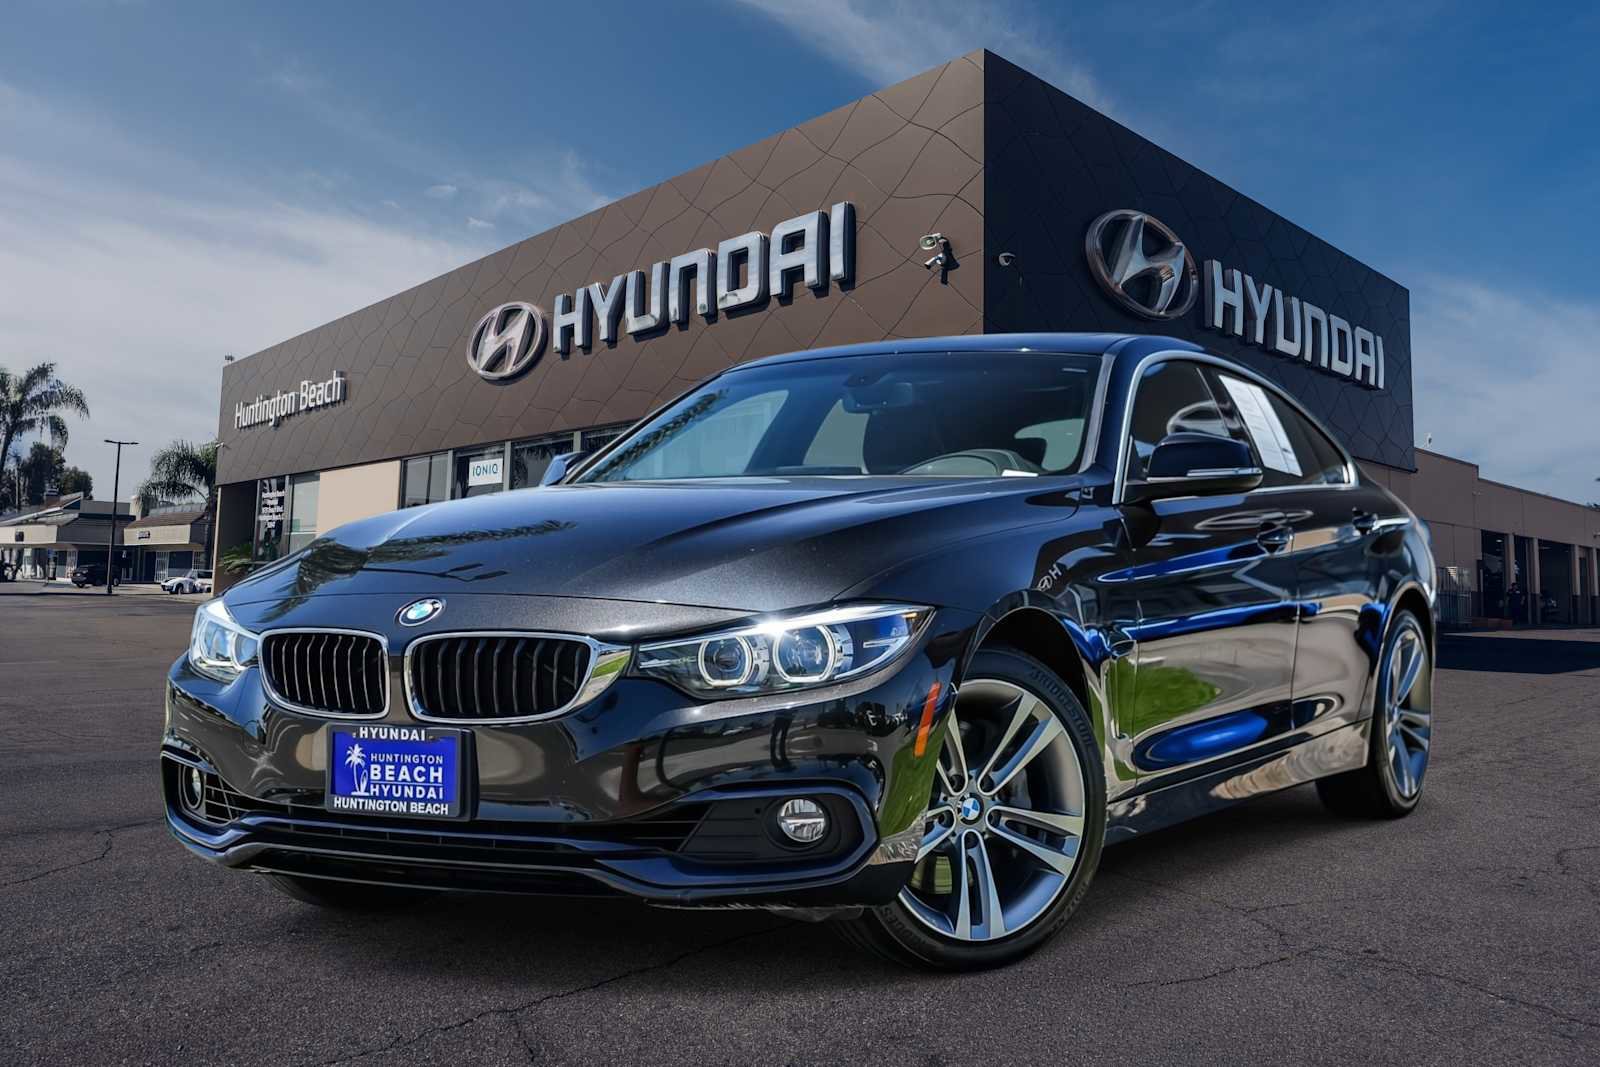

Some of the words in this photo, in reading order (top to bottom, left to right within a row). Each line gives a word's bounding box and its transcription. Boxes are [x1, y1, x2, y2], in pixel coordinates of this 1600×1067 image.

[552, 201, 854, 353] HYUNDAI
[1205, 259, 1385, 389] HYUNDAI
[234, 390, 297, 429] Huntington
[299, 370, 343, 410] Beach
[472, 463, 499, 477] IONIQ
[359, 726, 426, 741] HYUNDAI
[370, 753, 444, 765] HUNTINGTON
[370, 764, 443, 783] BEACH
[370, 783, 444, 800] HYUNDAI
[333, 796, 407, 813] HUNTINGTON
[410, 802, 449, 815] BEACH
